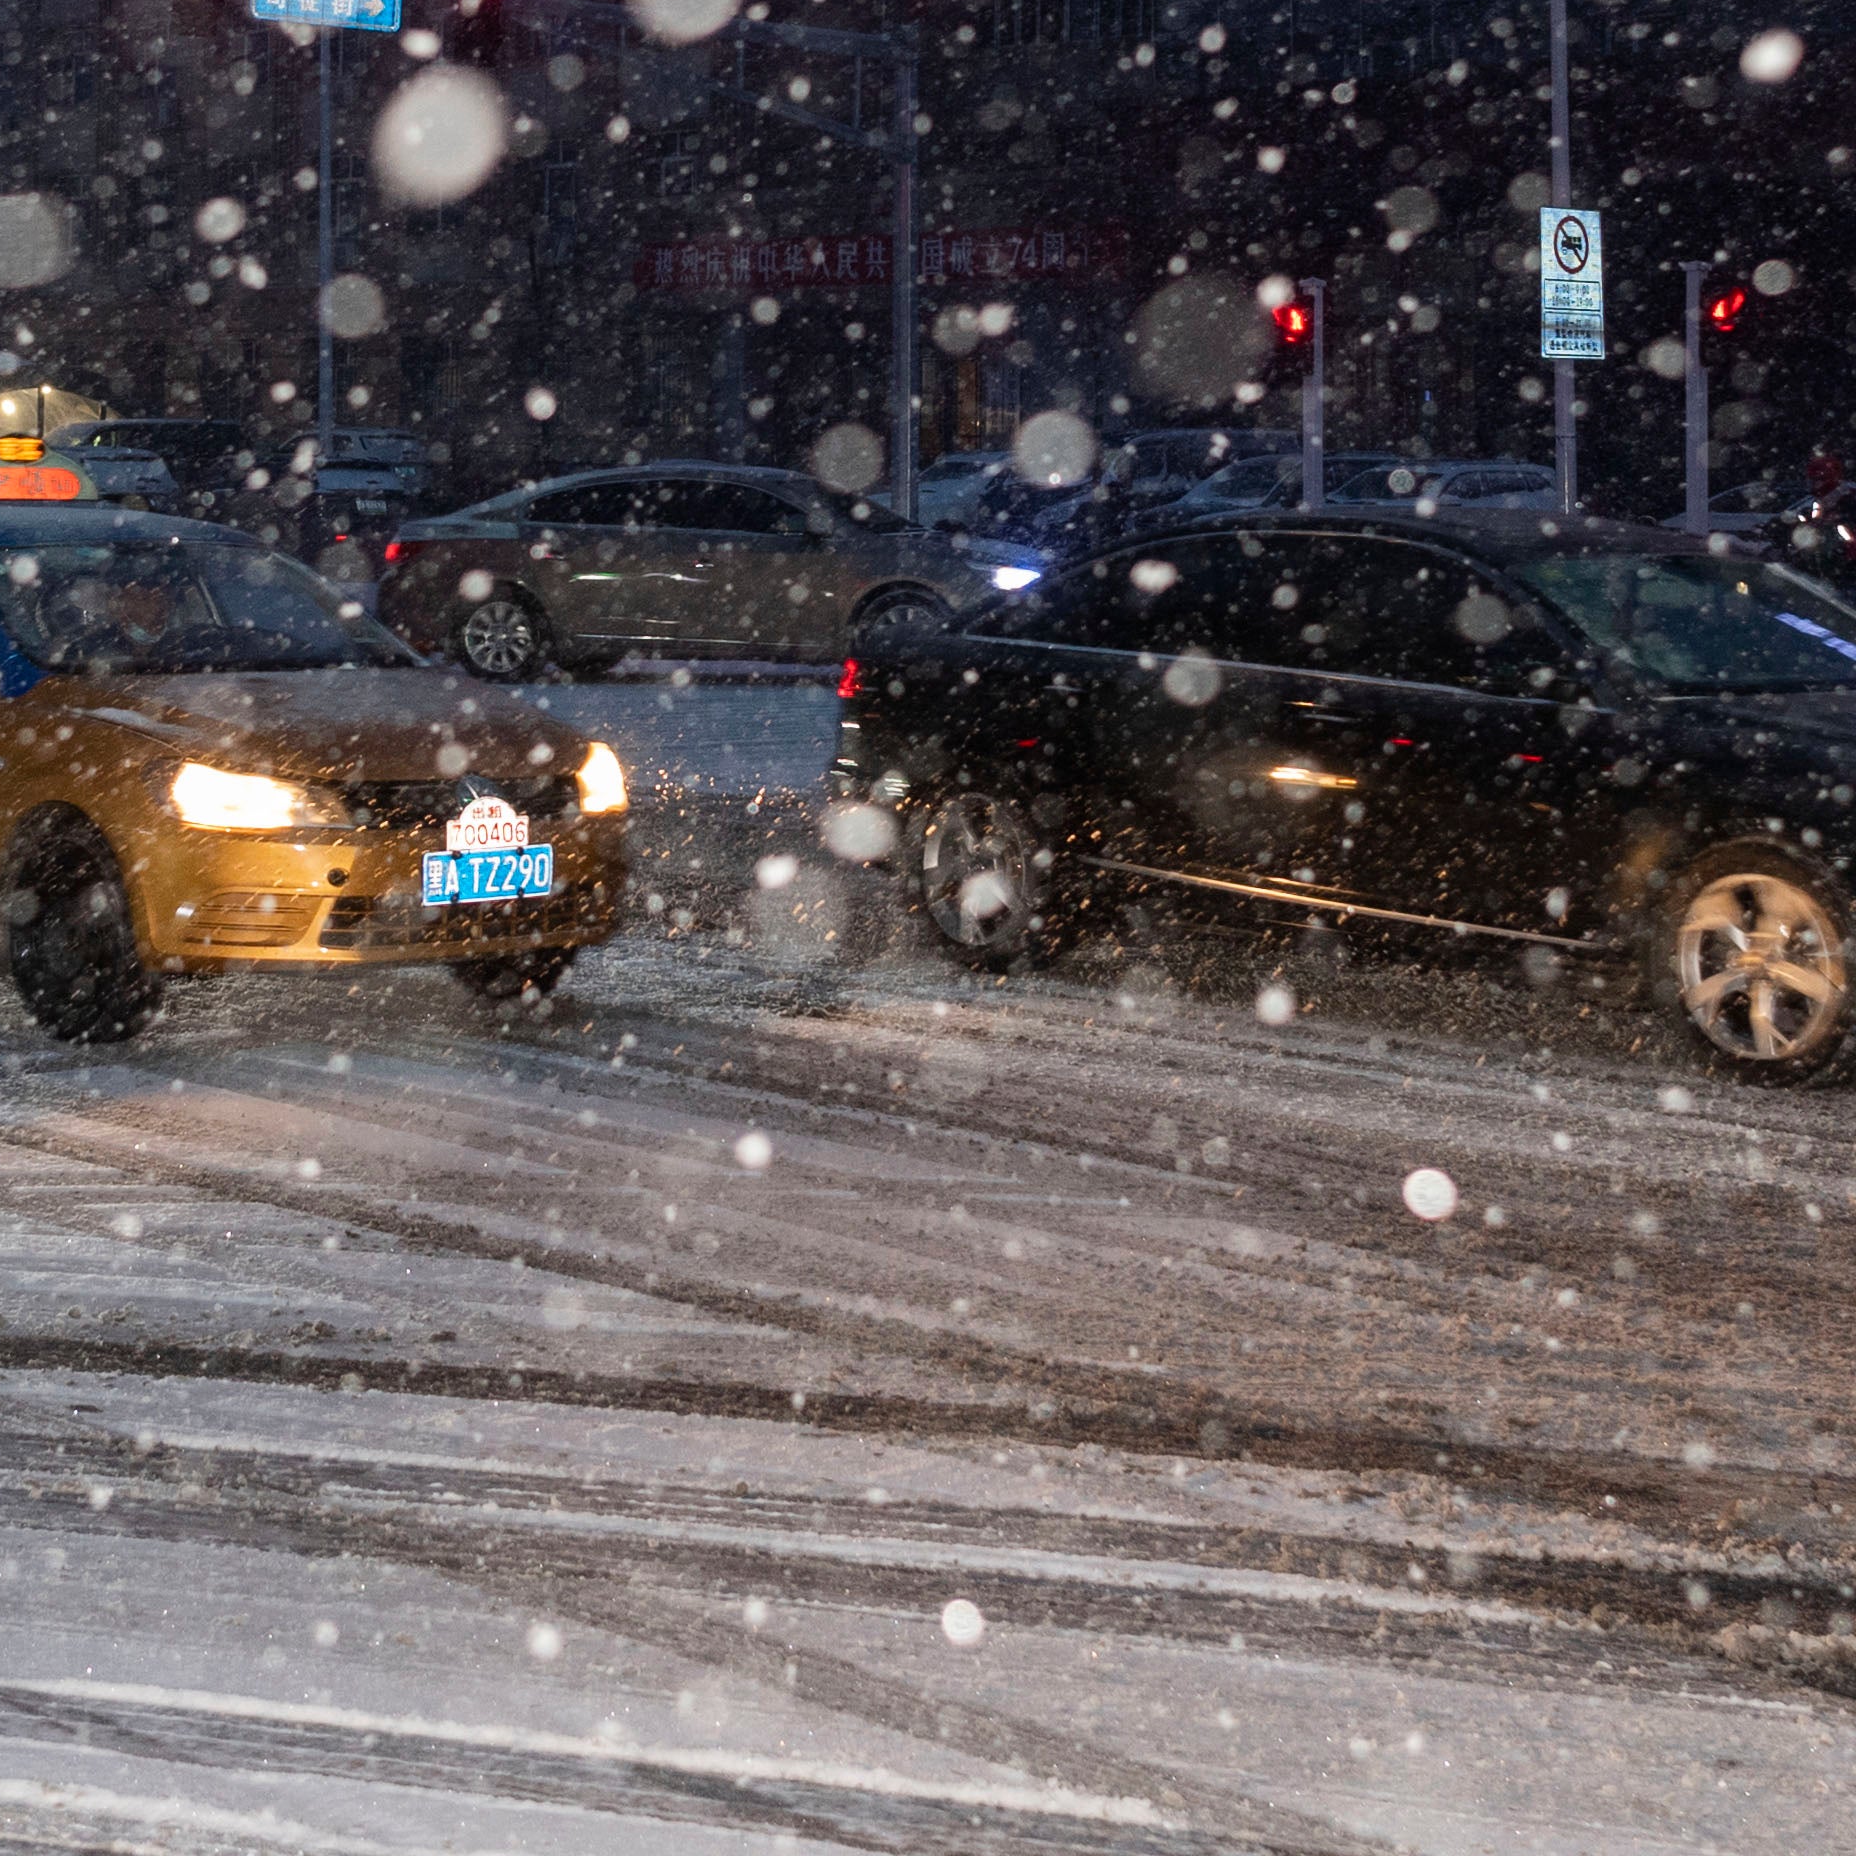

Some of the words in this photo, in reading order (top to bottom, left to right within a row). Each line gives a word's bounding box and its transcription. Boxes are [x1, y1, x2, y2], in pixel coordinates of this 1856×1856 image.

[653, 231, 1092, 284] 热烈庆祝中华人民共国成立74周
[452, 820, 526, 846] 700406
